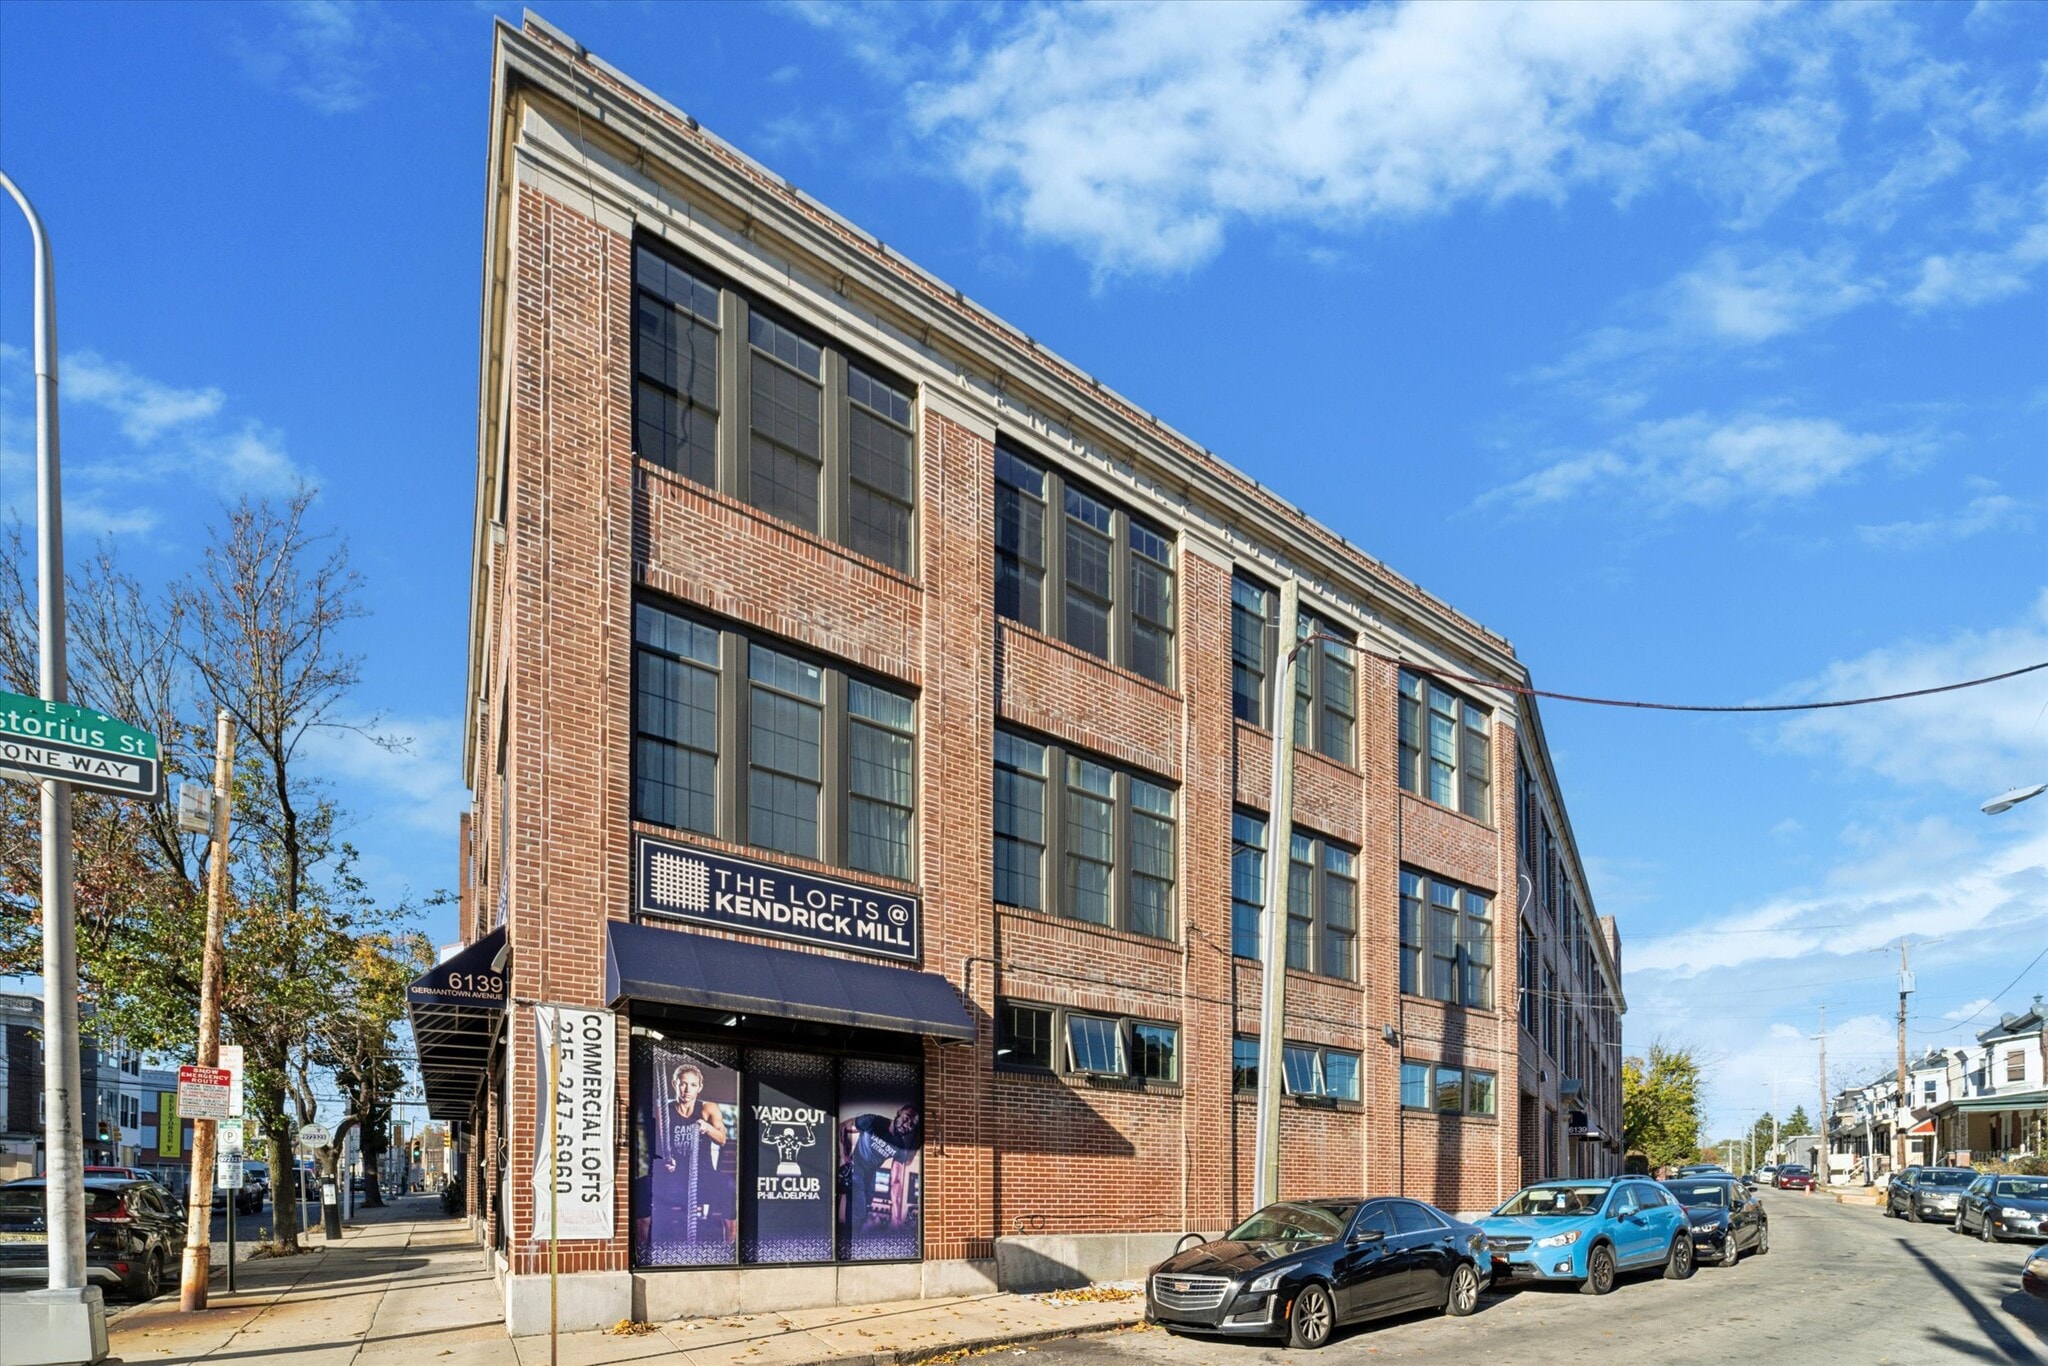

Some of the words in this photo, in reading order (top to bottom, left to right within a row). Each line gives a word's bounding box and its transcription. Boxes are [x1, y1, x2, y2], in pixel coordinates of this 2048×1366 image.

[45, 702, 56, 714] E
[120, 735, 146, 755] St
[4, 744, 61, 767] ONE
[72, 756, 128, 778] WAY
[715, 868, 775, 899] THE
[790, 885, 879, 920] LOFTS
[887, 904, 909, 926] @
[715, 891, 851, 936] KENDRICK
[857, 919, 910, 946] MILL
[448, 972, 503, 993] 6139
[411, 986, 471, 998] GERMANTOWN
[472, 991, 503, 1000] AVENUE
[181, 1072, 229, 1081] EMERGENCY
[582, 1014, 602, 1141] COMMERCIAL
[751, 1105, 792, 1121] YARD
[795, 1108, 827, 1124] OUT
[674, 1132, 693, 1142] STO
[581, 1147, 600, 1203] LOFTS
[757, 1177, 780, 1191] FIT
[781, 1177, 821, 1192] CLUB
[757, 1191, 821, 1200] PHILADELPHIA
